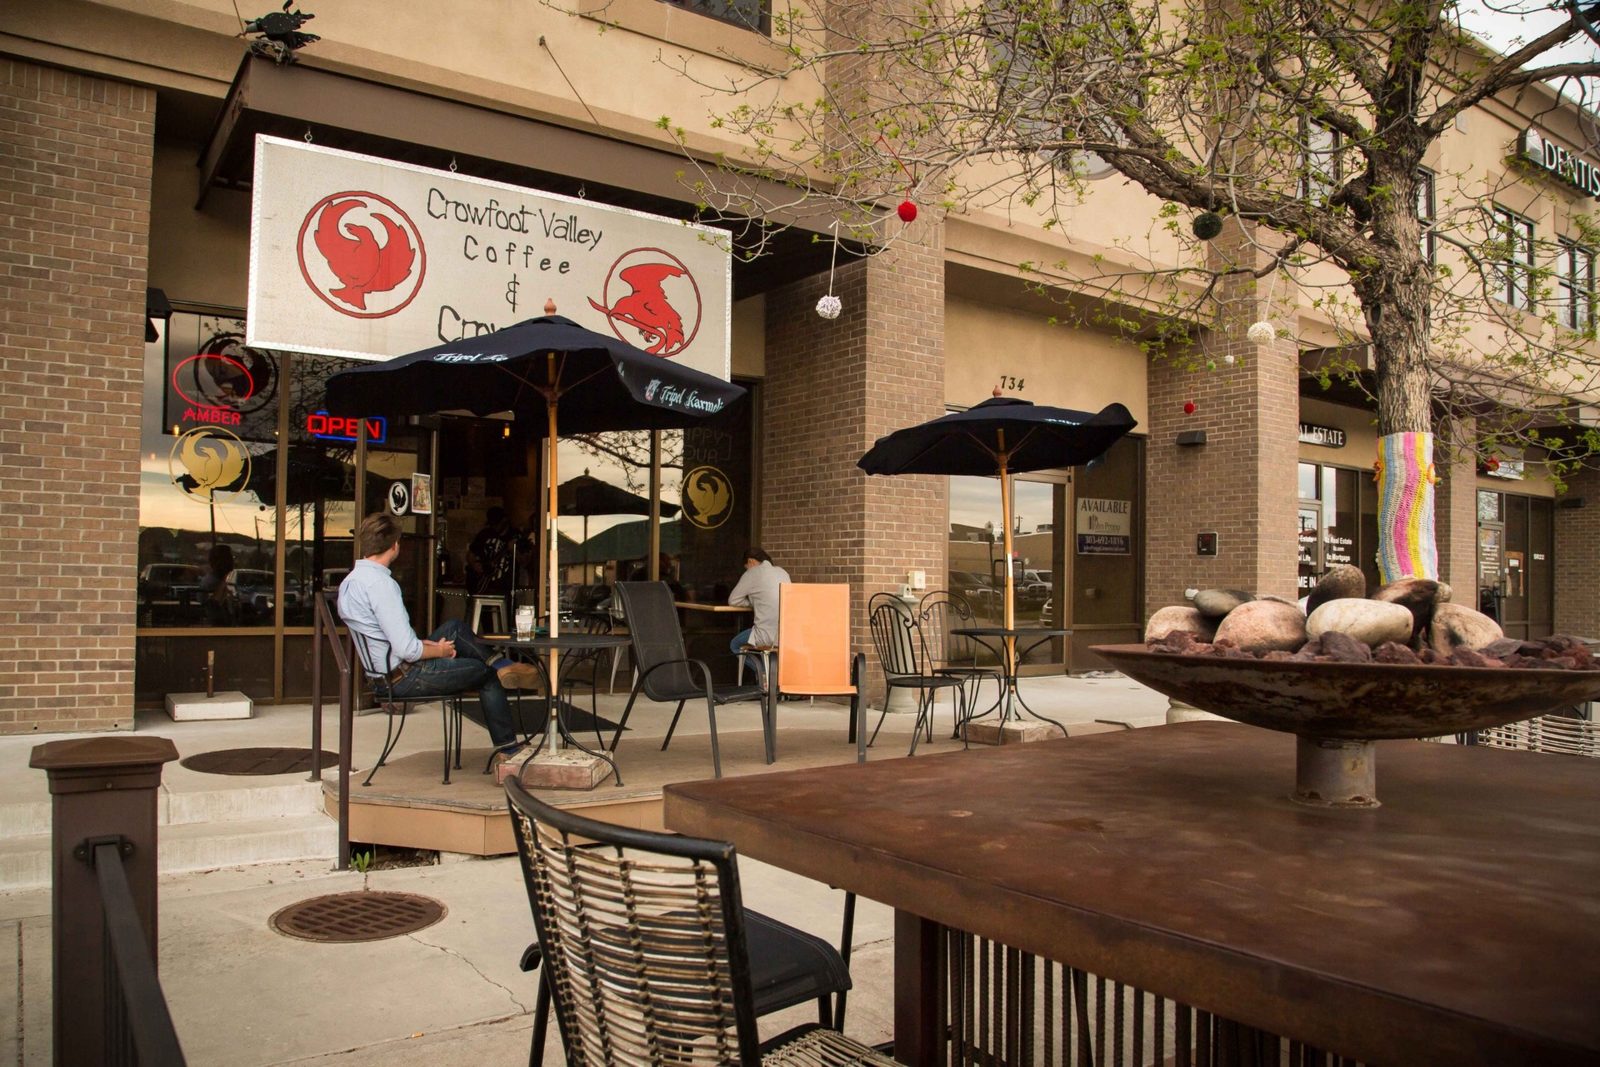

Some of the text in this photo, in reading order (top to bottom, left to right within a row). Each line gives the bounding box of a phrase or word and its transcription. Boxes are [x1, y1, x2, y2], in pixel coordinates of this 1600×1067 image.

[1544, 138, 1600, 196] DENTIS
[427, 187, 603, 252] Crowfoot Valley
[464, 235, 571, 275] Coffee
[1000, 375, 1025, 391] 734
[660, 385, 687, 407] Tripel
[182, 408, 241, 425] AMBER
[307, 414, 380, 439] OPEN
[1312, 426, 1344, 446] ESTATE
[1080, 499, 1129, 514] AVAILABLE
